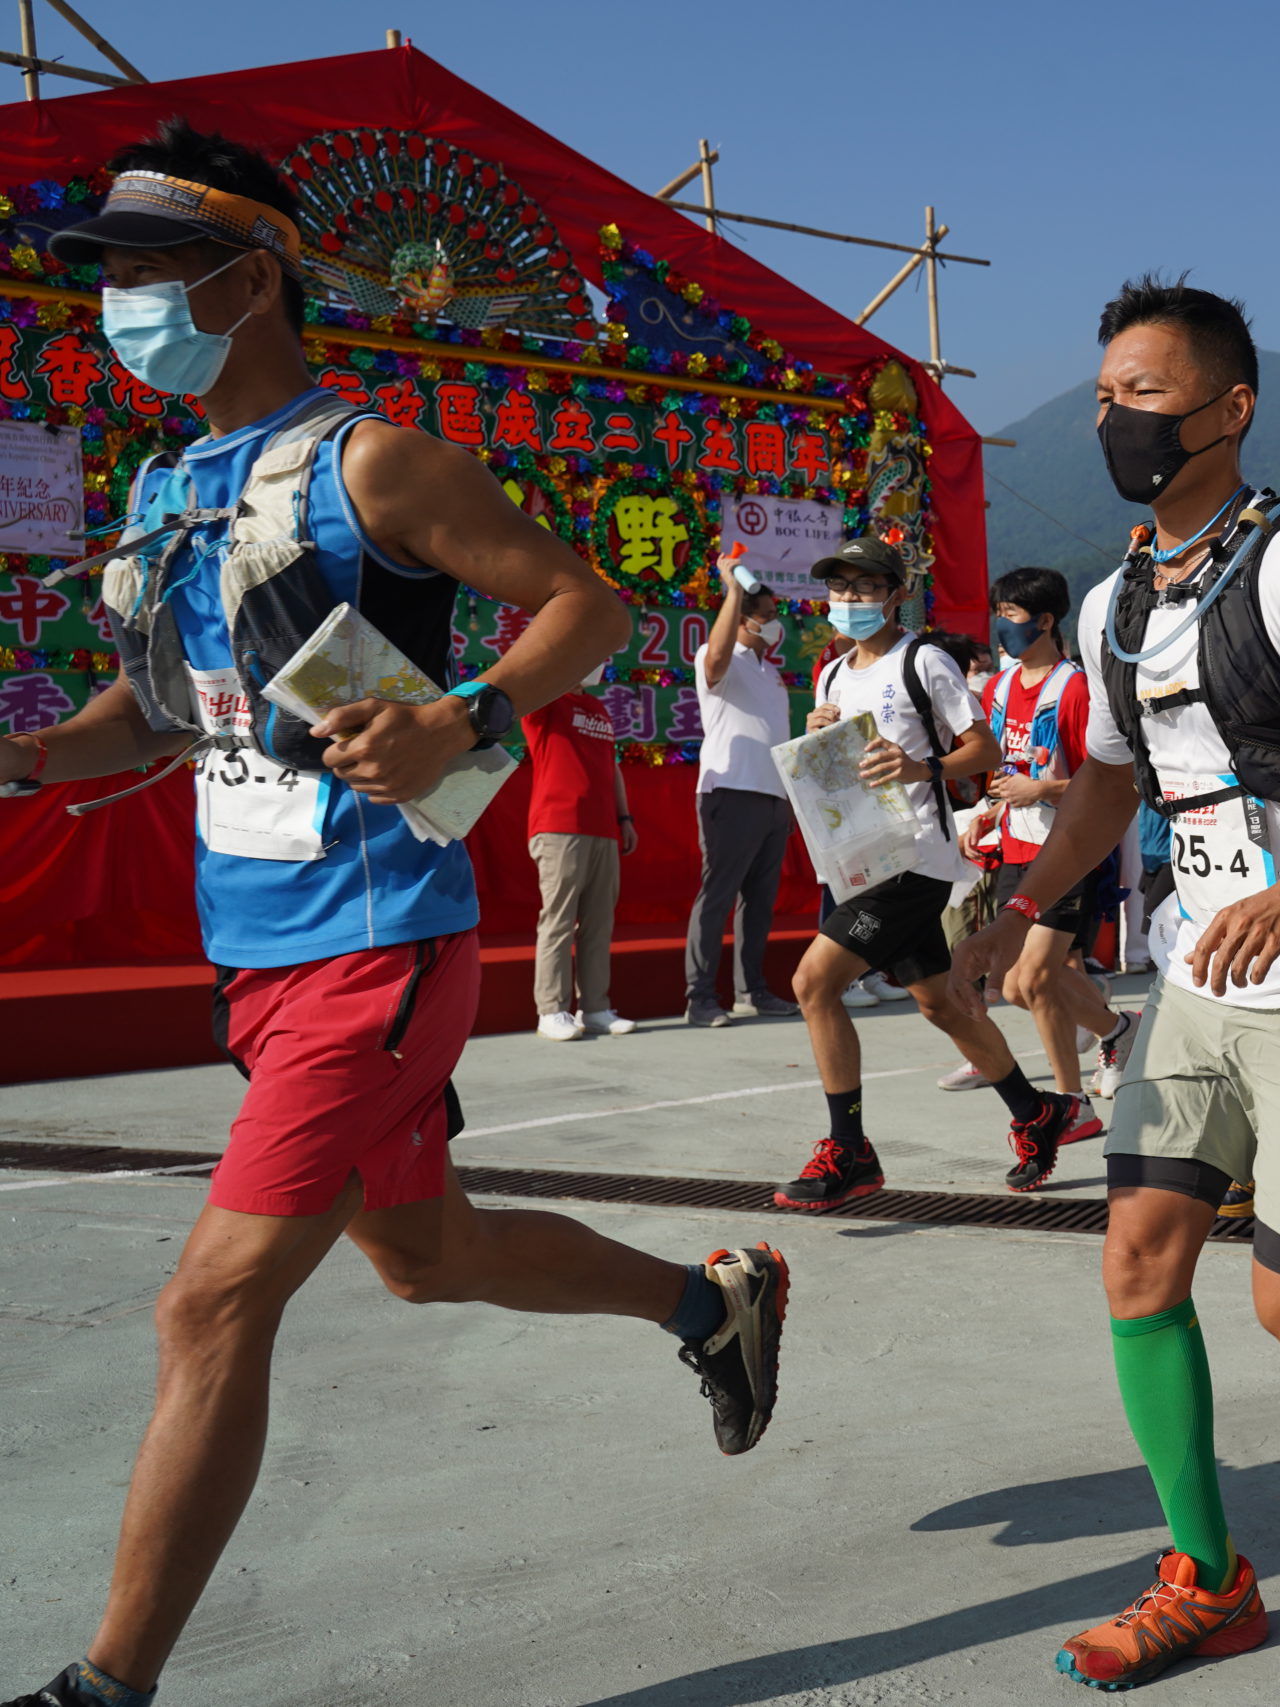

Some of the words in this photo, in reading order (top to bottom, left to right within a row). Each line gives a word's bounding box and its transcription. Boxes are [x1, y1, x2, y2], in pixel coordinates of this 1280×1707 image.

[612, 493, 689, 582] 野
[775, 526, 801, 537] BOC
[804, 529, 831, 541] LIFE
[1172, 832, 1250, 878] 25-4
